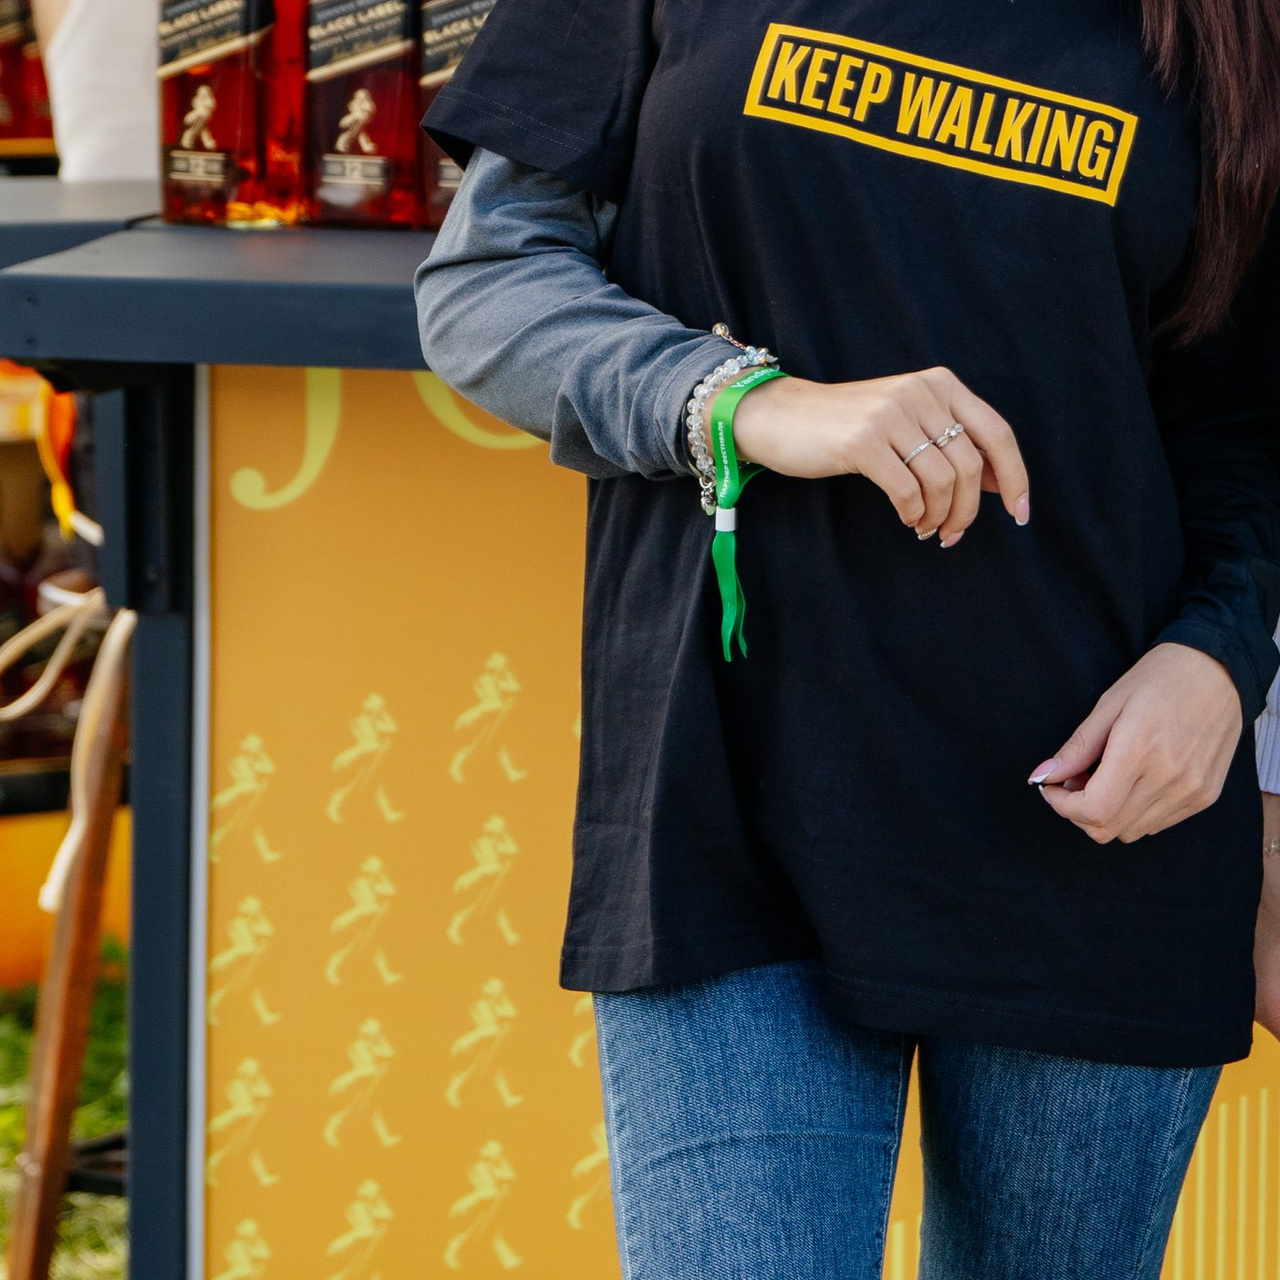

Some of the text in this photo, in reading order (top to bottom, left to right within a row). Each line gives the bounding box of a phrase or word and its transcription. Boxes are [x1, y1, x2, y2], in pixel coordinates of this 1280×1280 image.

[308, 13, 357, 40] BLACK
[423, 19, 472, 45] BLACK
[767, 41, 1115, 181] KEEP WALKING
